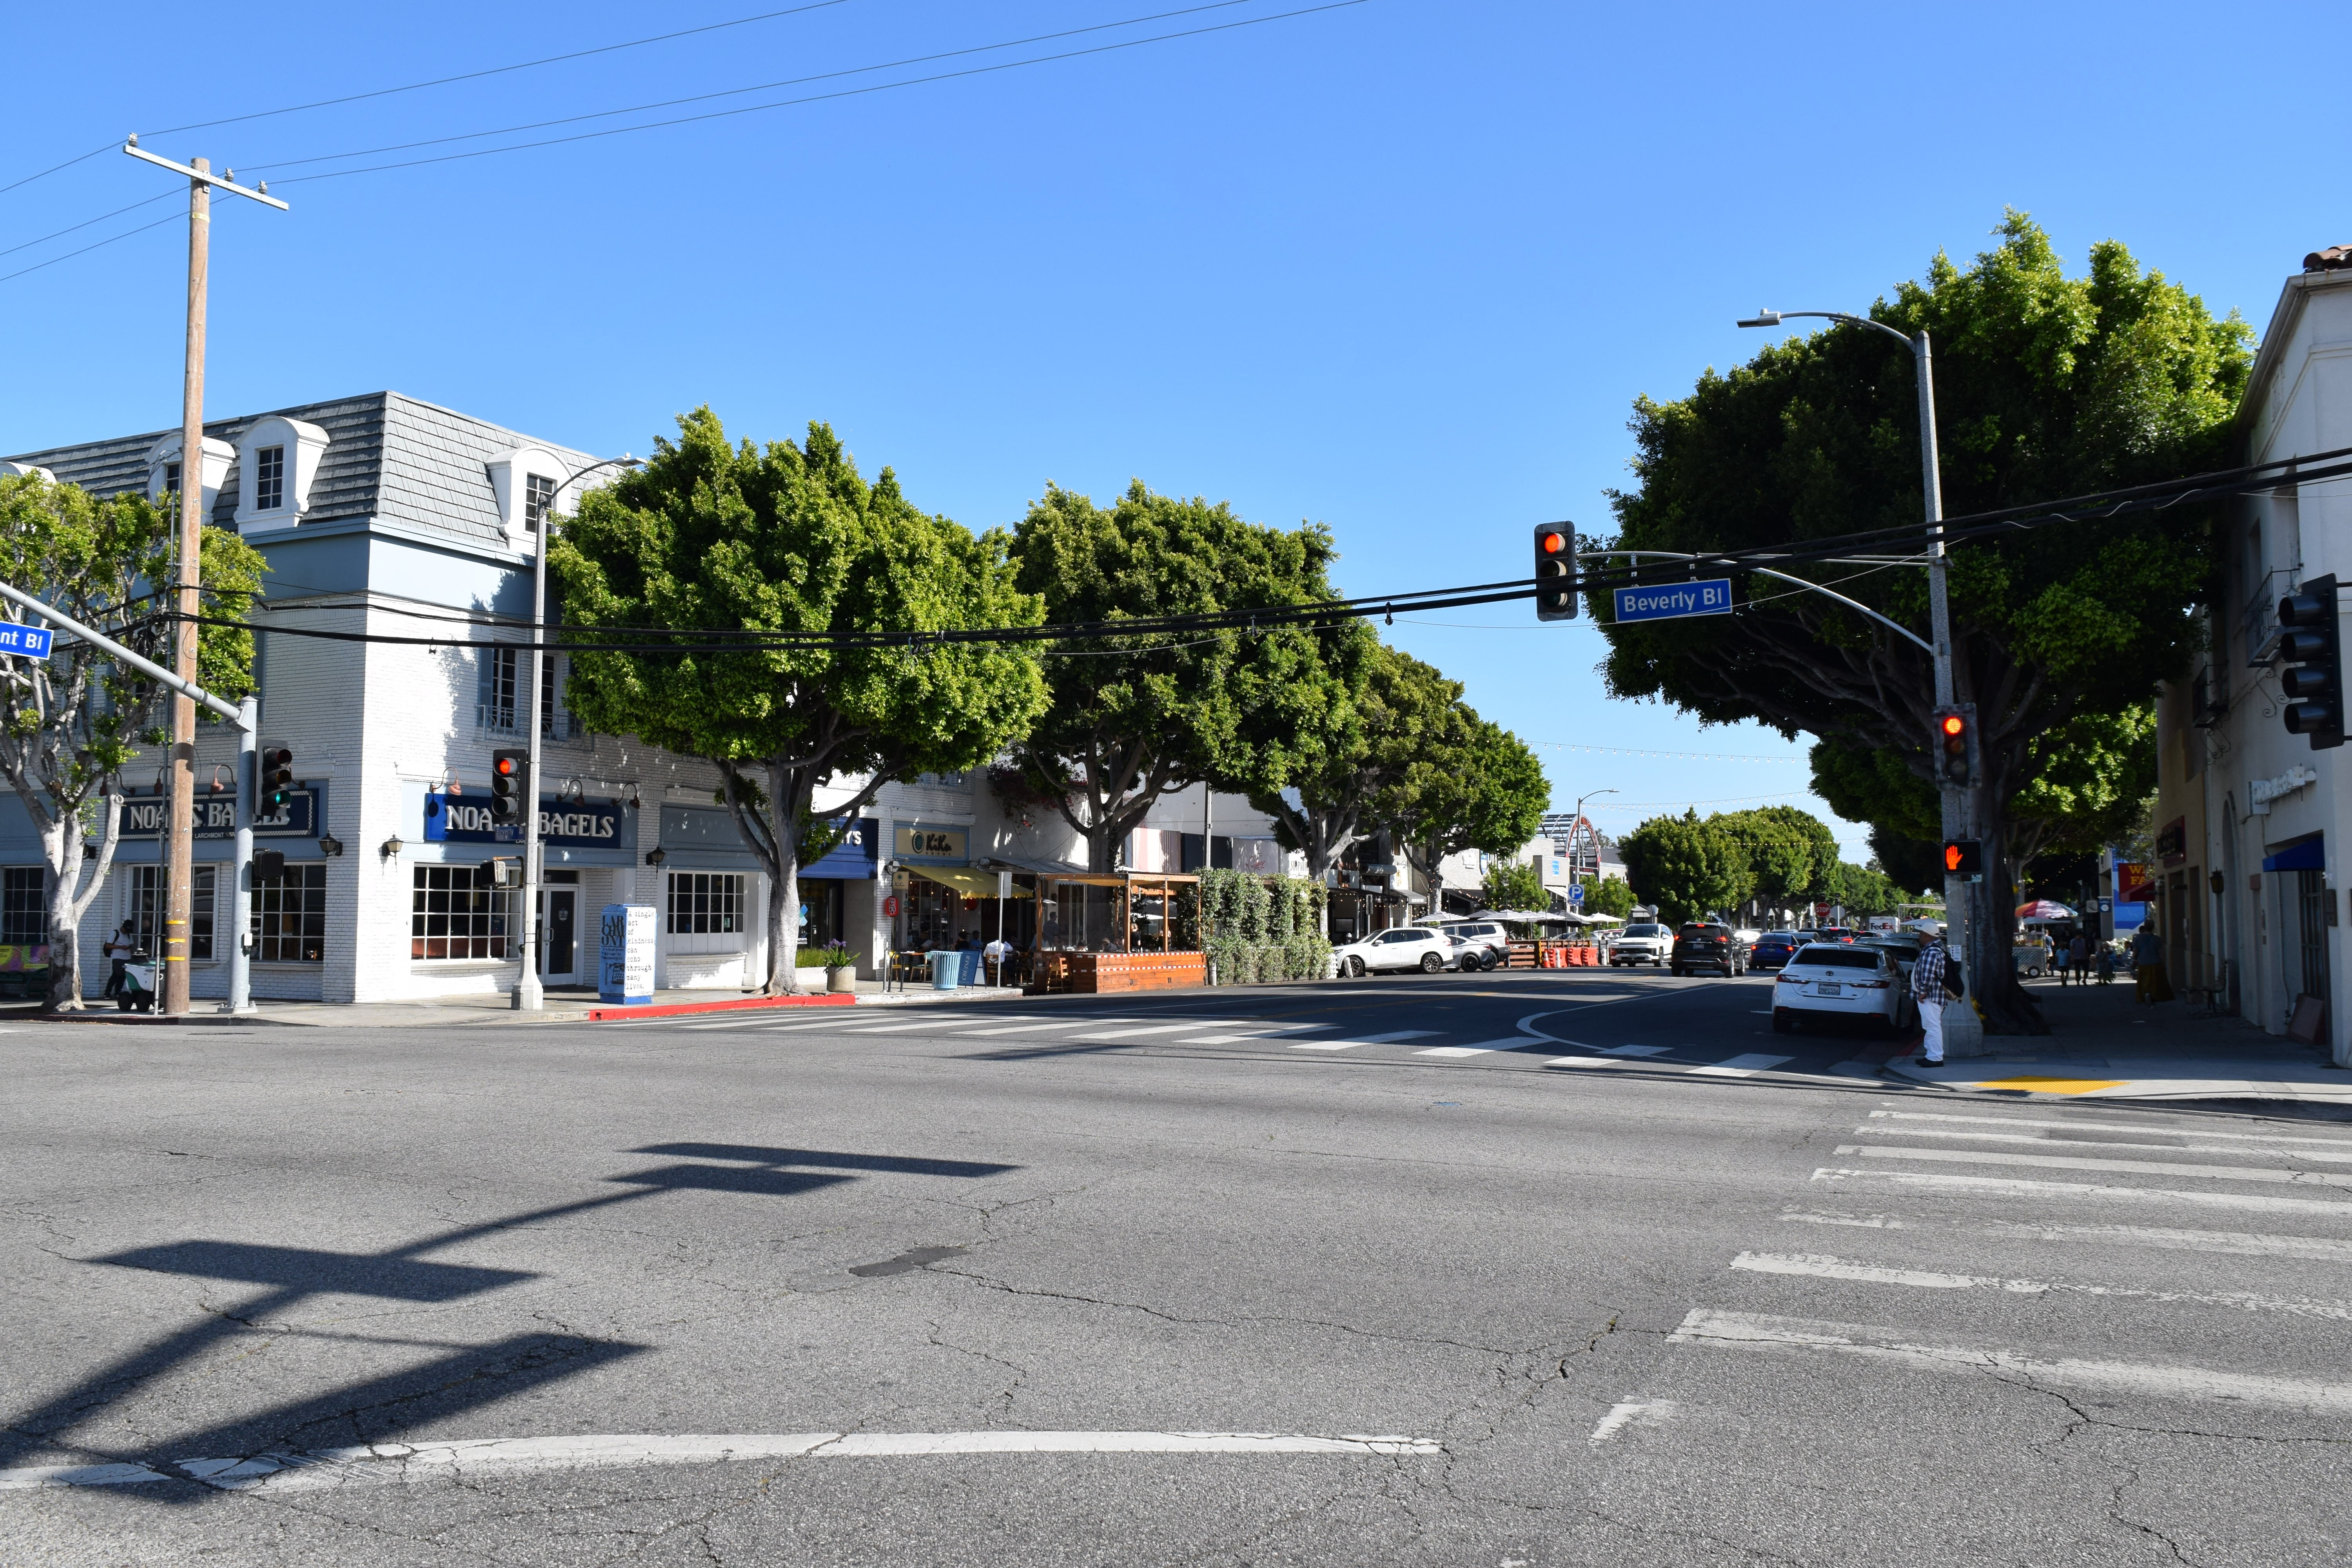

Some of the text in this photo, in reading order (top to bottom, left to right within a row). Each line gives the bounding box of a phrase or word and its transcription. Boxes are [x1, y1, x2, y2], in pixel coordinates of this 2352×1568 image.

[1624, 588, 1722, 612] Beverly Bl
[25, 633, 43, 650] Bl
[496, 828, 514, 836] Beverly
[538, 811, 614, 838] BAGELS
[962, 955, 971, 980] CRUISER
